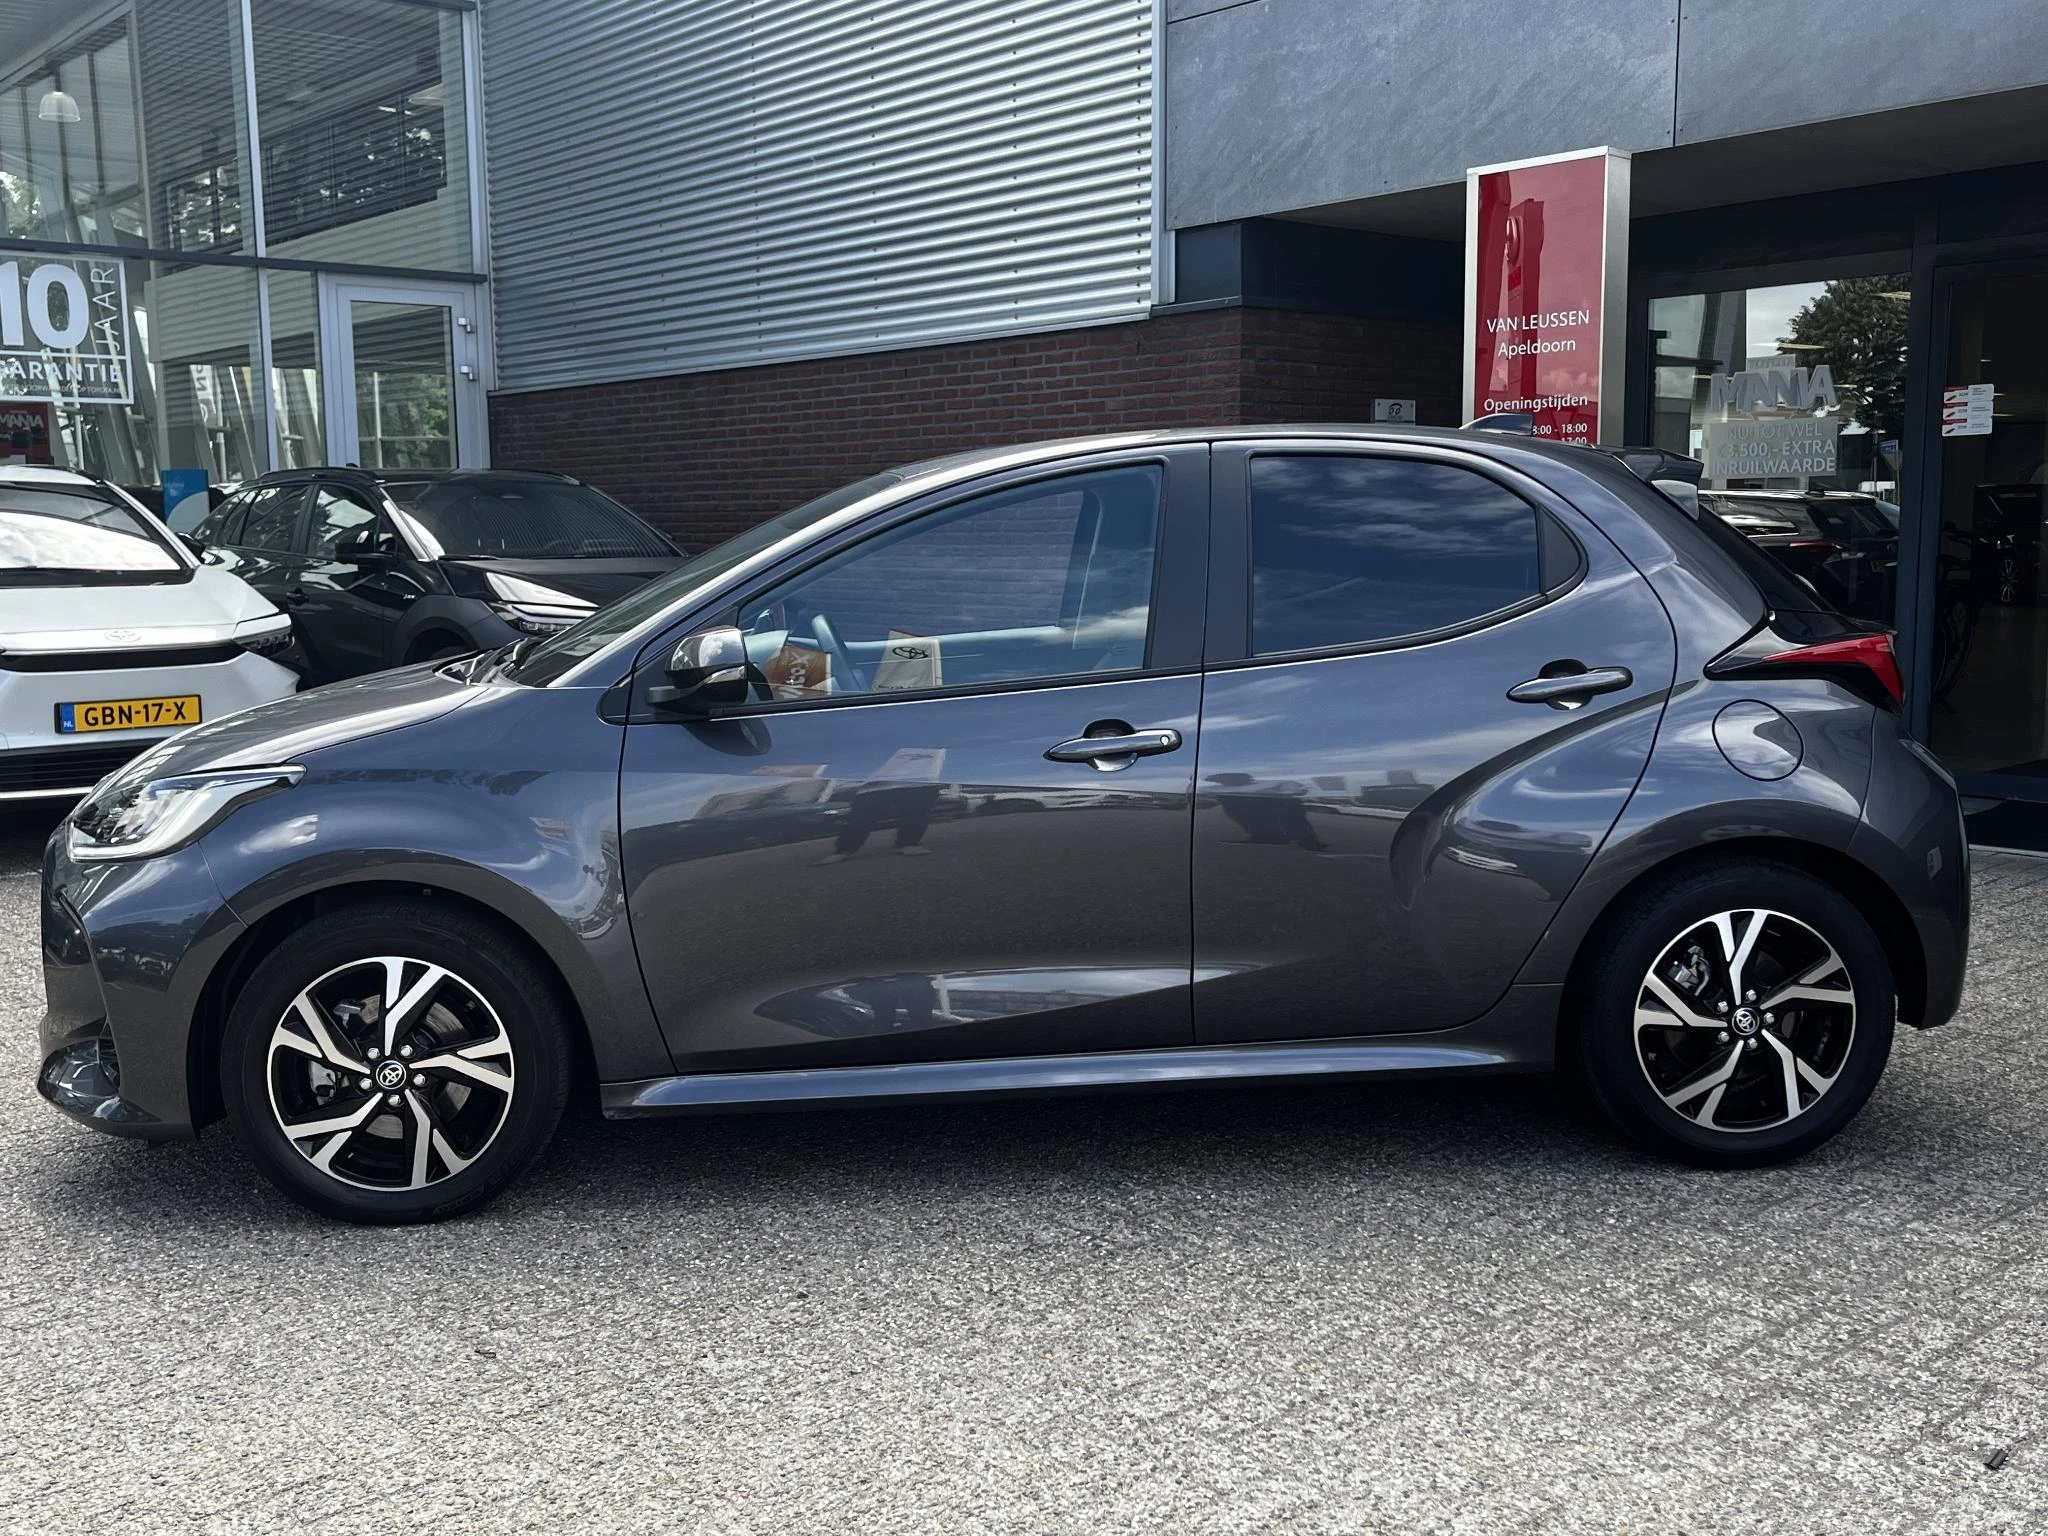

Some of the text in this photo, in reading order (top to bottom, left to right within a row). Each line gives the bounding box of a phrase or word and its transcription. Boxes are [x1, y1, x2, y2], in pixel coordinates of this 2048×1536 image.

[0, 261, 90, 349] 10
[90, 267, 121, 351] JAAR
[1486, 310, 1590, 333] VAN LEUSSEN
[1498, 338, 1576, 360] Apeldoorn
[1711, 364, 1838, 414] MANIA
[1484, 394, 1588, 414] Openingstijden
[1561, 423, 1587, 434] 18:00
[1728, 421, 1823, 440] NU TOT WEL
[1782, 439, 1835, 456] EXTRA
[1712, 457, 1836, 476] INRUILWAARDE
[84, 701, 186, 727] GBN-17-X
